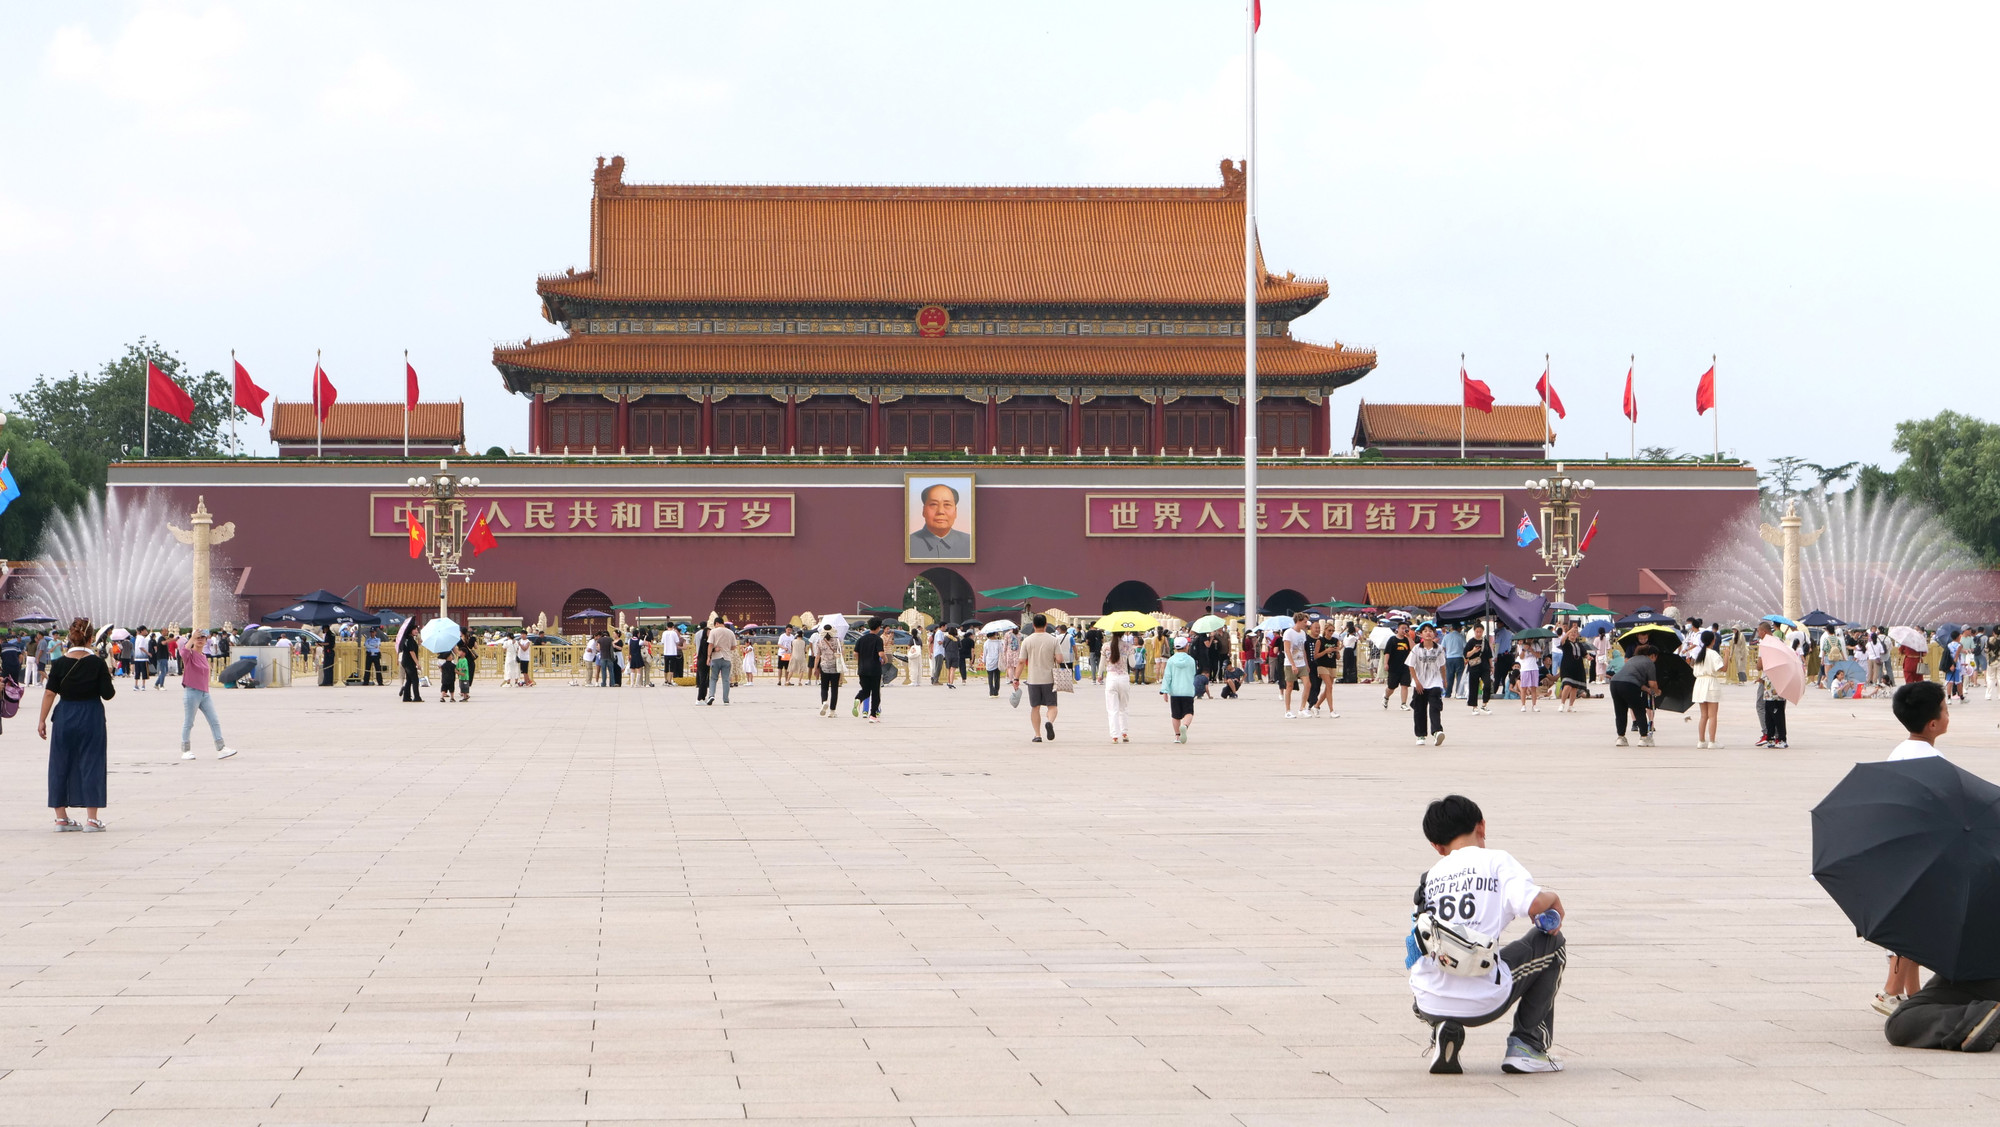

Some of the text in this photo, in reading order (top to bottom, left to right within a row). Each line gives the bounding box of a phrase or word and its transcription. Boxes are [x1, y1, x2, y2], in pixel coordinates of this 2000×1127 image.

[1109, 502, 1481, 531] 世界人民大团结万岁
[1449, 877, 1473, 893] PLAY
[1476, 877, 1499, 893] DICE
